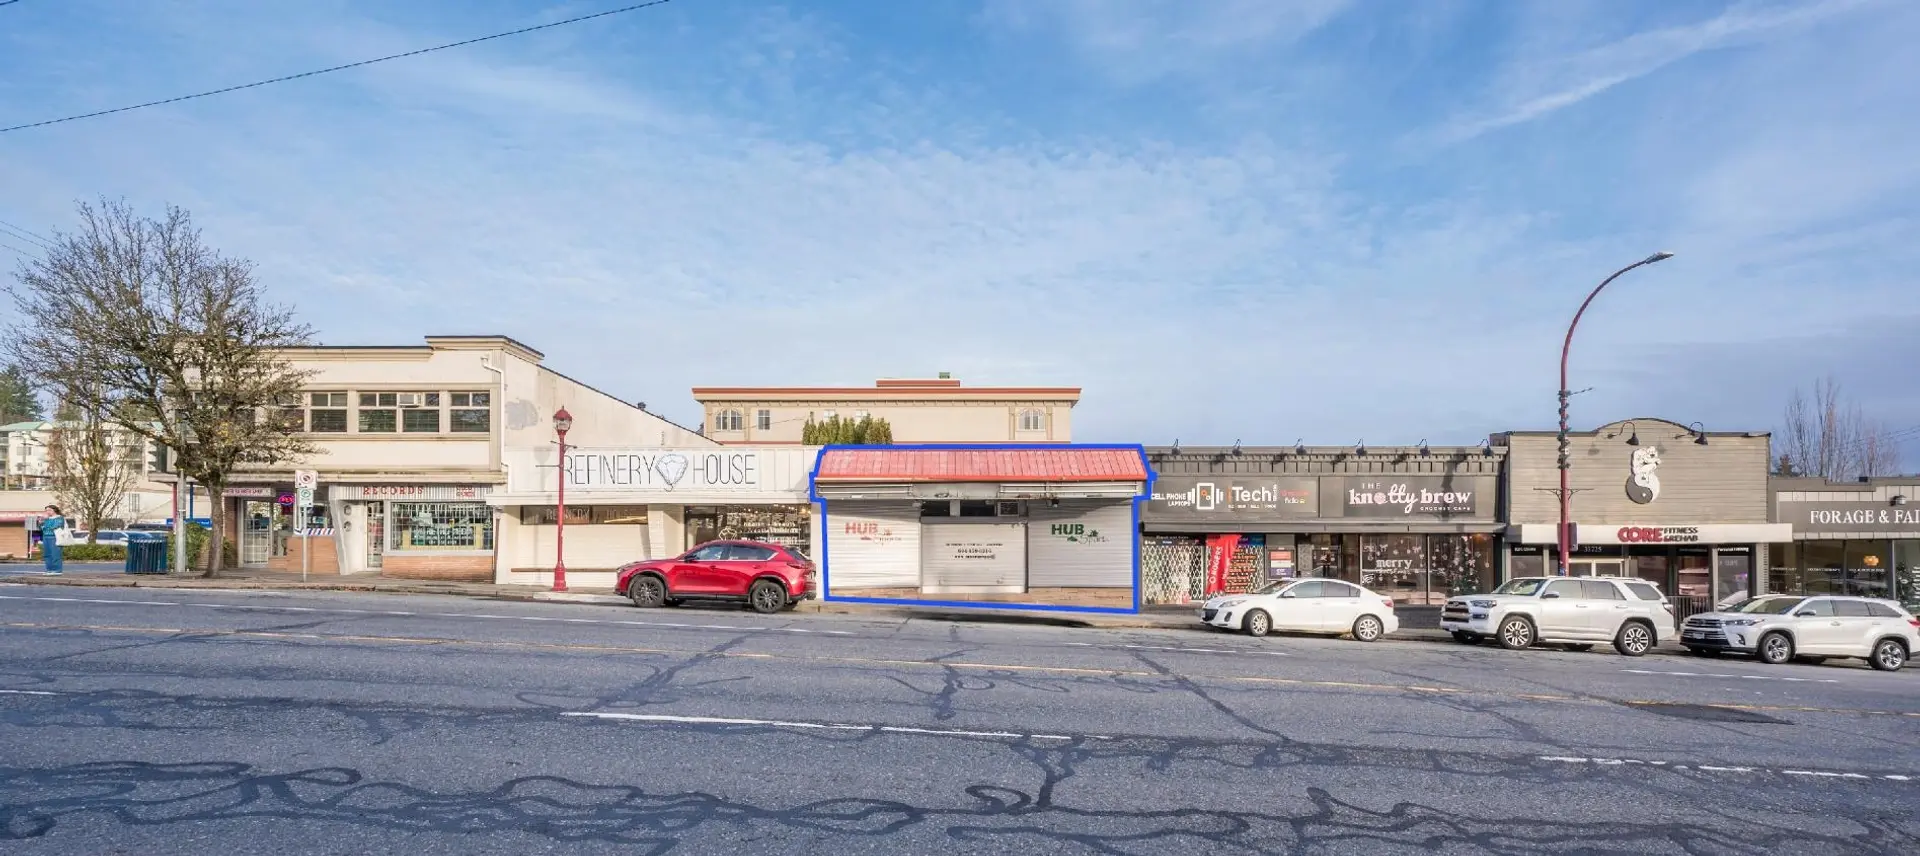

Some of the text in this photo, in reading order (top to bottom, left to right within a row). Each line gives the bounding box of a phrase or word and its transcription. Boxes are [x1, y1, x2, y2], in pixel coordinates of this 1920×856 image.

[564, 454, 756, 485] REFINERY HOUSE
[363, 485, 424, 495] RECORDS
[1348, 484, 1471, 514] knotty brew
[1810, 510, 1874, 524] FORAGE
[1879, 510, 1890, 524] &
[845, 522, 878, 534] HUB
[1051, 524, 1085, 535] HUB
[1617, 527, 1663, 542] CORE
[1376, 560, 1412, 569] merry
